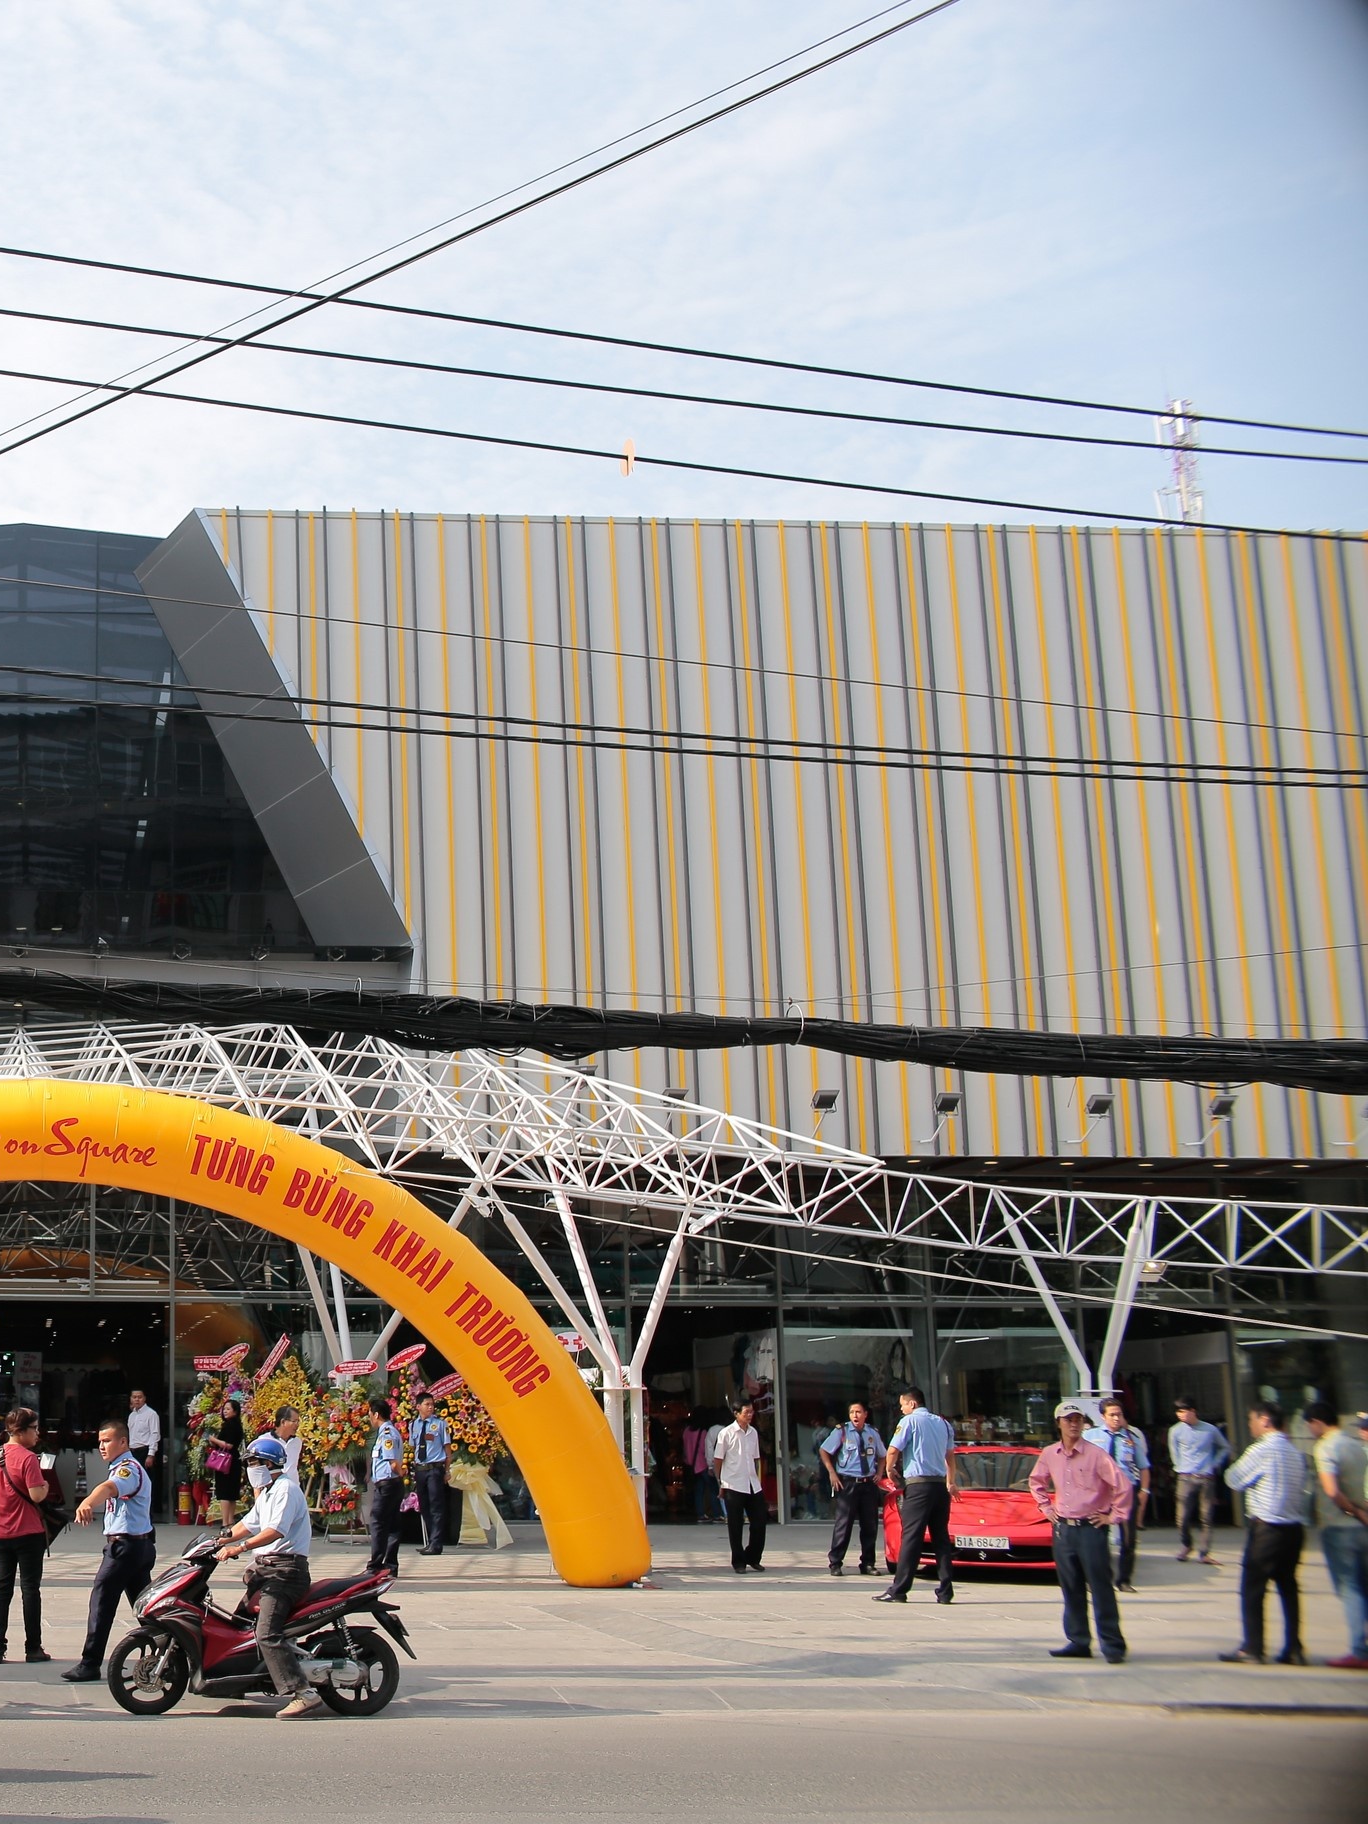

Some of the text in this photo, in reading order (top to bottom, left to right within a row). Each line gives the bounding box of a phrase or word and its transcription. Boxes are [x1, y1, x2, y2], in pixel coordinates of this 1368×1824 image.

[190, 1134, 551, 1398] TƯNG BỪNG KHAI TRƯƠNG
